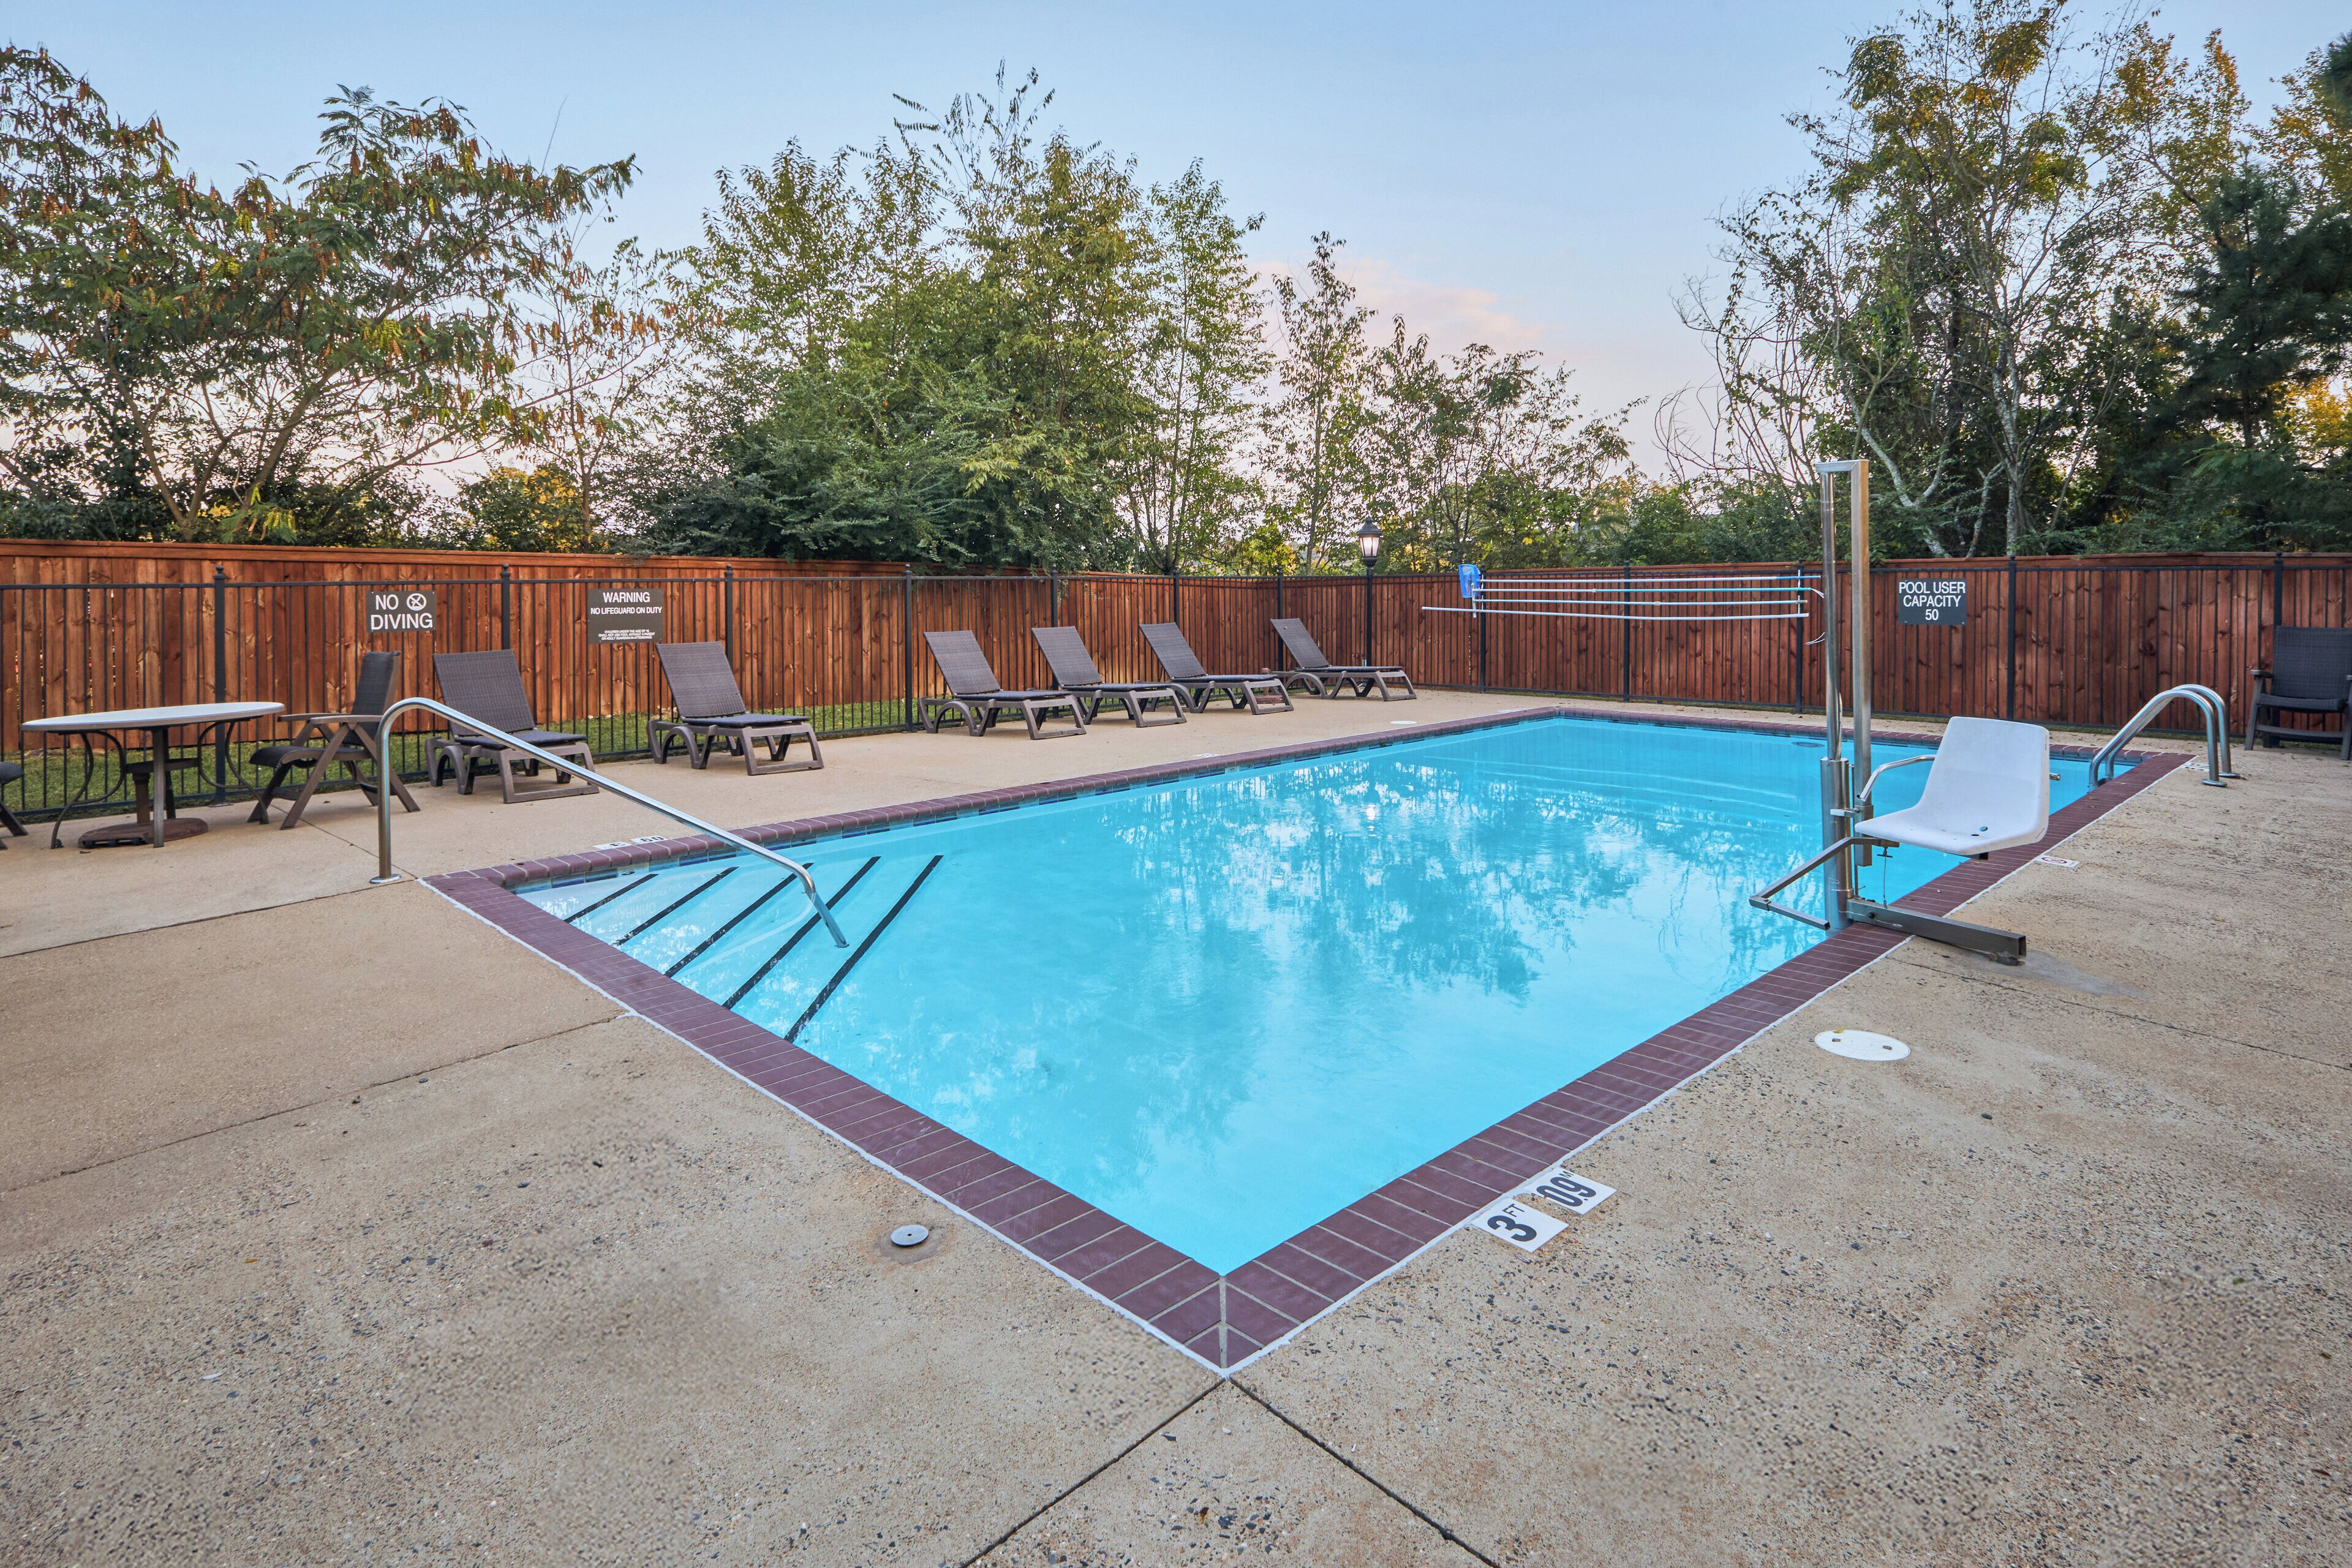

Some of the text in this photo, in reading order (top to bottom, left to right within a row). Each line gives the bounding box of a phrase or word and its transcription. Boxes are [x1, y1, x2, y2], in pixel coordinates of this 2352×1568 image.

[1899, 582, 1966, 594] POOL USER
[375, 594, 399, 610] NO
[603, 592, 650, 603] WARNING
[1903, 595, 1961, 607] CAPACITY
[1925, 609, 1939, 620] 50
[371, 612, 432, 630] DIVING
[1487, 1203, 1537, 1242] 3 FT
